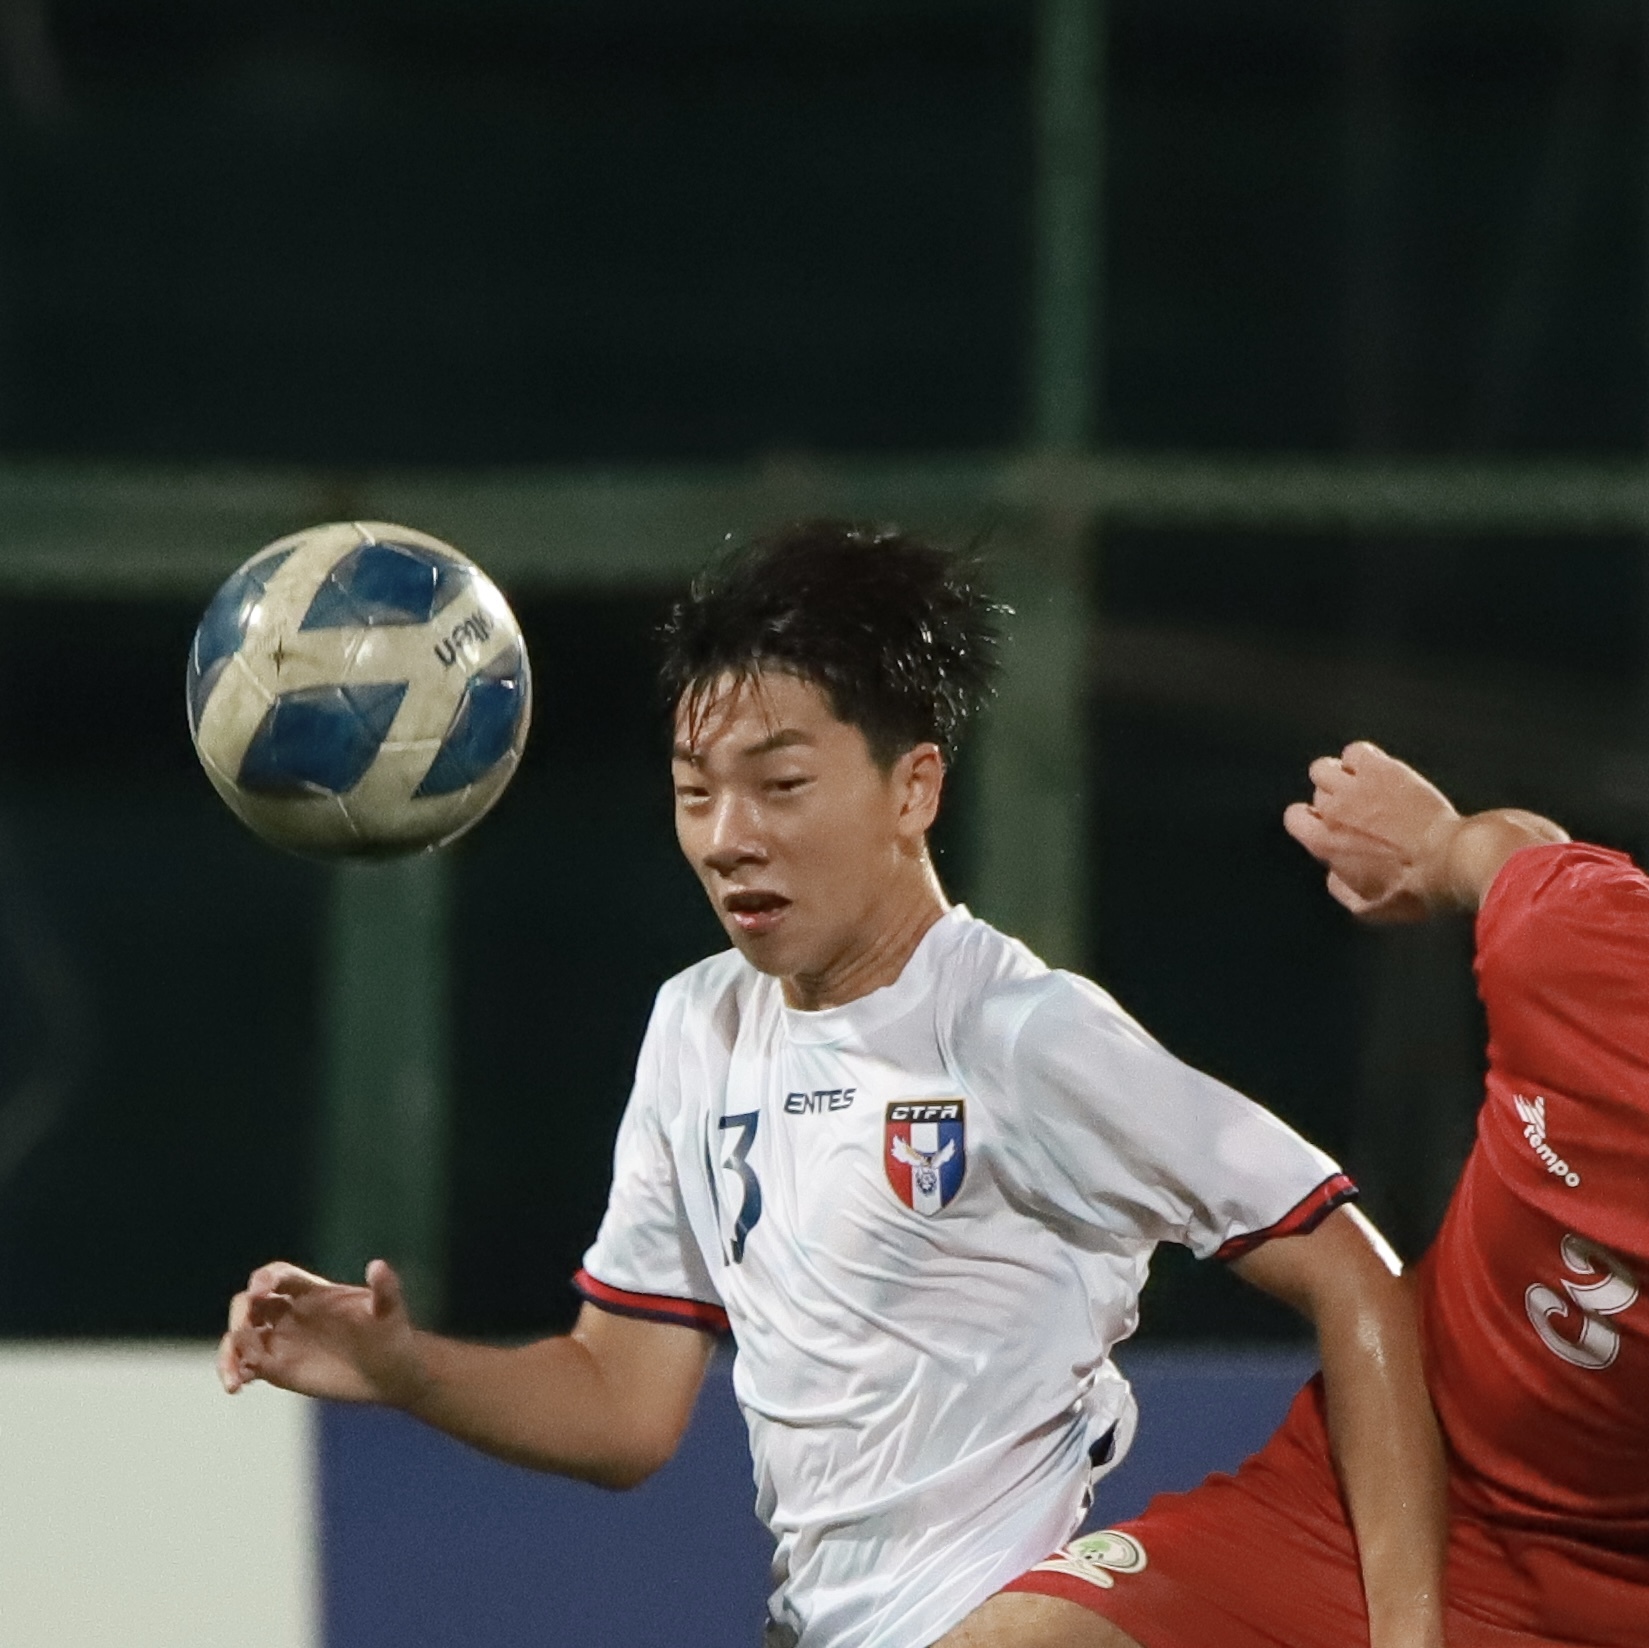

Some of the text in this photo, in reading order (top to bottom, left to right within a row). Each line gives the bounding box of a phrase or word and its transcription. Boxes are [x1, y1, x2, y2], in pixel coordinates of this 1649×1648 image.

[783, 1088, 856, 1115] ENTES
[890, 1104, 958, 1122] CTFA
[1524, 1232, 1640, 1371] 3
